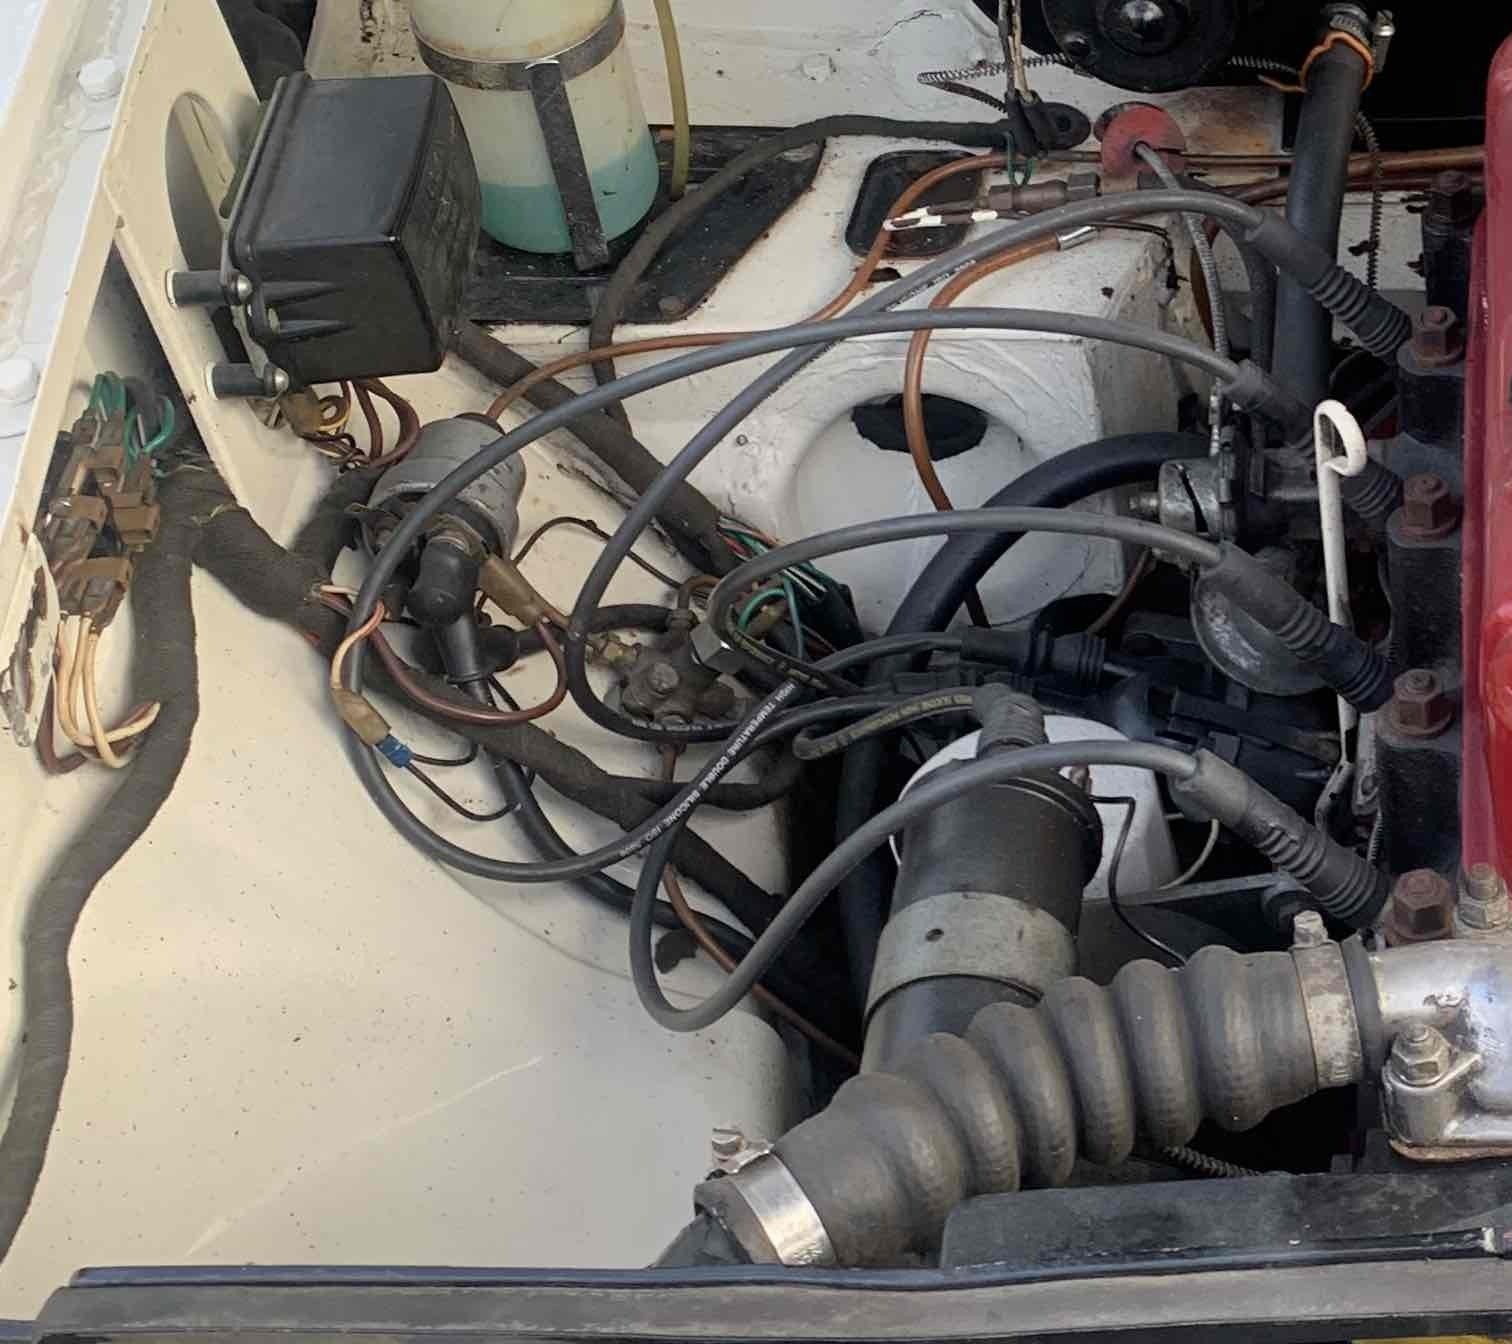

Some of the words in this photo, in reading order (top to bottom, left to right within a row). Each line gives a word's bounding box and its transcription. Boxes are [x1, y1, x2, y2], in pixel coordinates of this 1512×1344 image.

[727, 701, 777, 757] TEMPERATURE
[699, 755, 730, 791] DOUBLE
[663, 789, 701, 826] SILICONE
